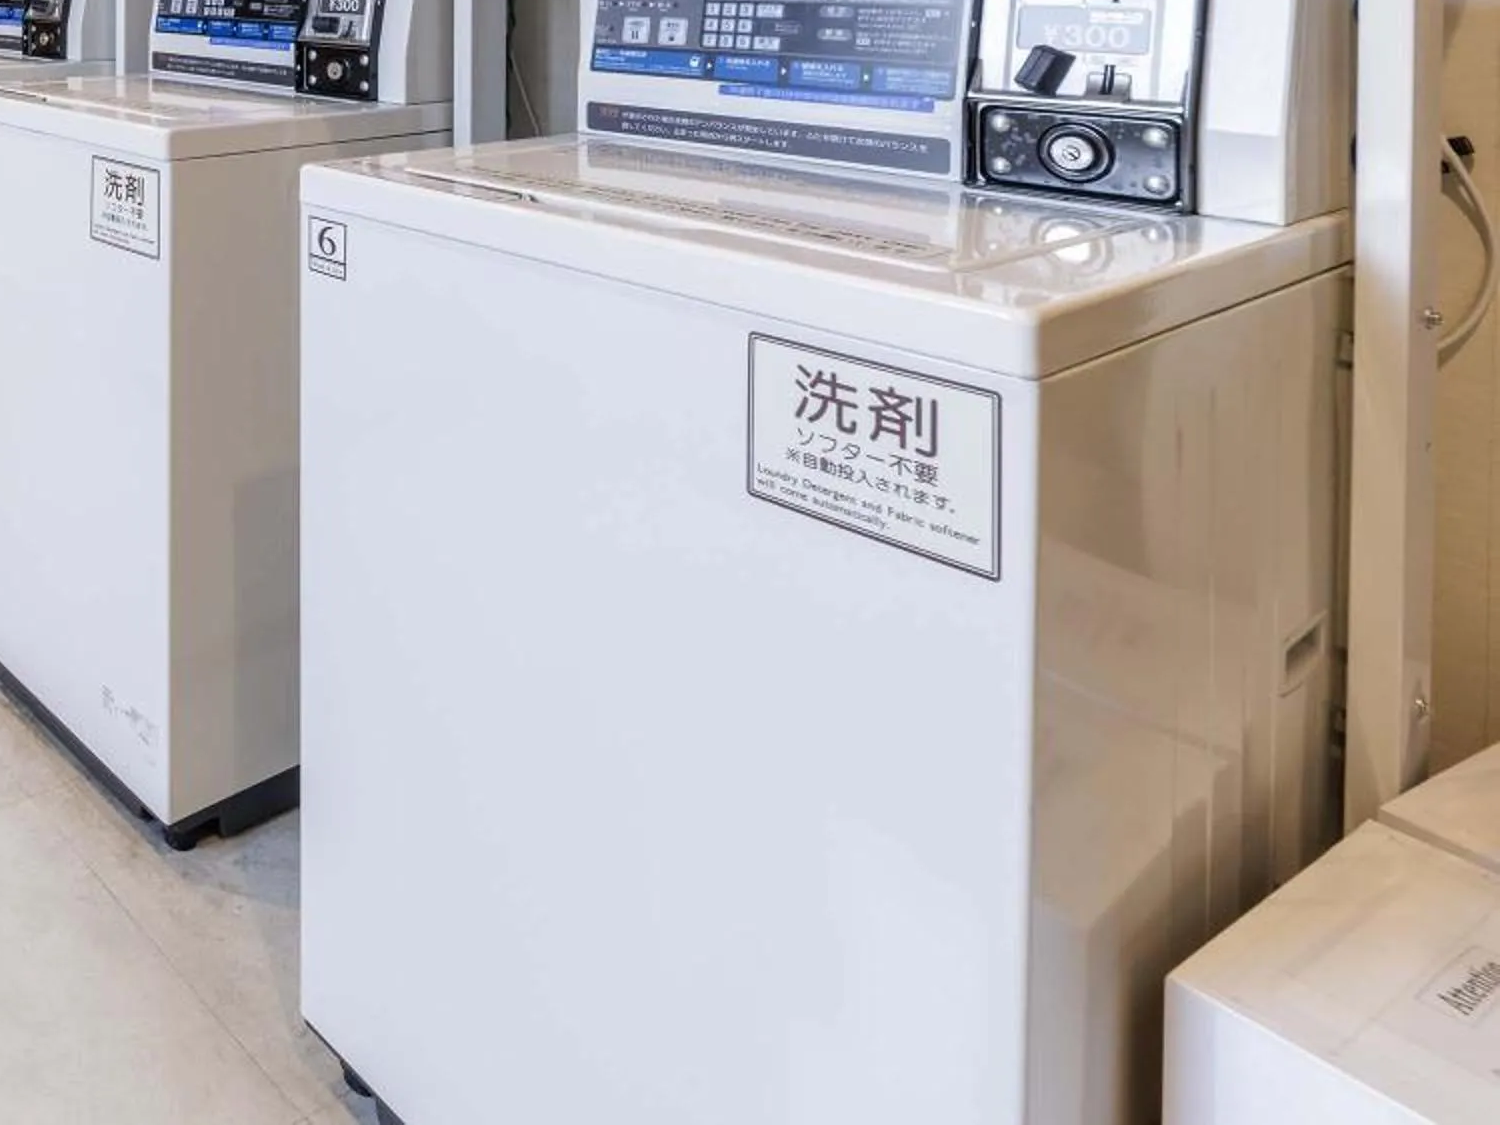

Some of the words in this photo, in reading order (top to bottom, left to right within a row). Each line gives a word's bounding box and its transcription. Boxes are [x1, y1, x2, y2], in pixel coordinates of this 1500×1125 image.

[1043, 22, 1132, 49] ¥300
[104, 167, 145, 206] 洗剤
[317, 225, 337, 256] 6
[794, 363, 938, 458] 洗剤
[796, 427, 940, 488] ソフター不要
